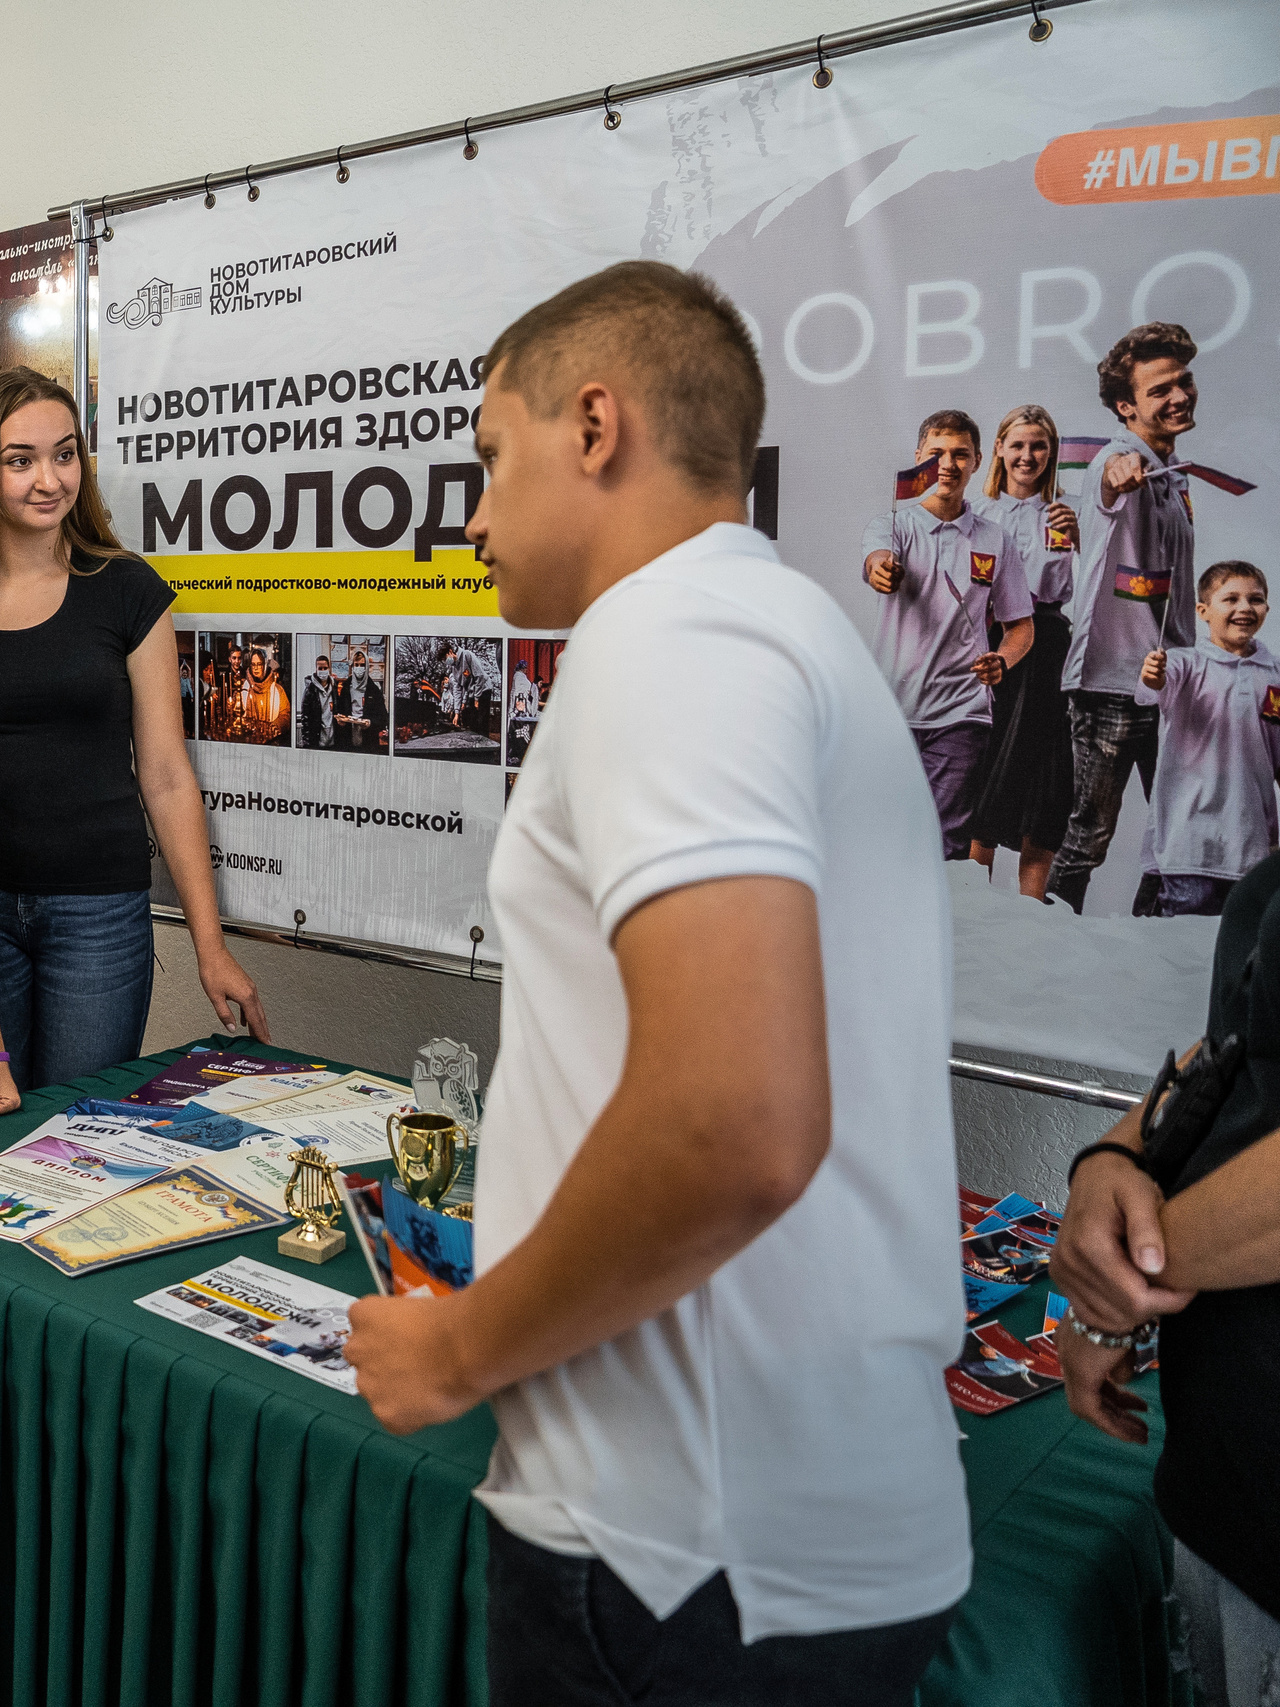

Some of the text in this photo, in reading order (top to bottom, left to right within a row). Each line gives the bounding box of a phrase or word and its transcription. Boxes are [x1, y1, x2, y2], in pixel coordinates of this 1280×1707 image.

[10, 258, 63, 283] ансамбль
[210, 231, 397, 283] НОВОТИТАРОВСКИЙ
[210, 278, 250, 302] ДОМ
[210, 286, 302, 315] КУЛЬТУРЫ
[740, 250, 1280, 385] OBRO
[117, 416, 342, 464] ТЕРРИТОРИЯ
[236, 575, 446, 593] подростково-молодежный
[451, 575, 493, 594] клуб
[226, 852, 282, 875] KDONSP.RU
[31, 1158, 107, 1183] ДИПЛОМ
[155, 1189, 213, 1223] ГРАМОТА
[201, 1278, 322, 1328] МОЛОДЕЖИ
